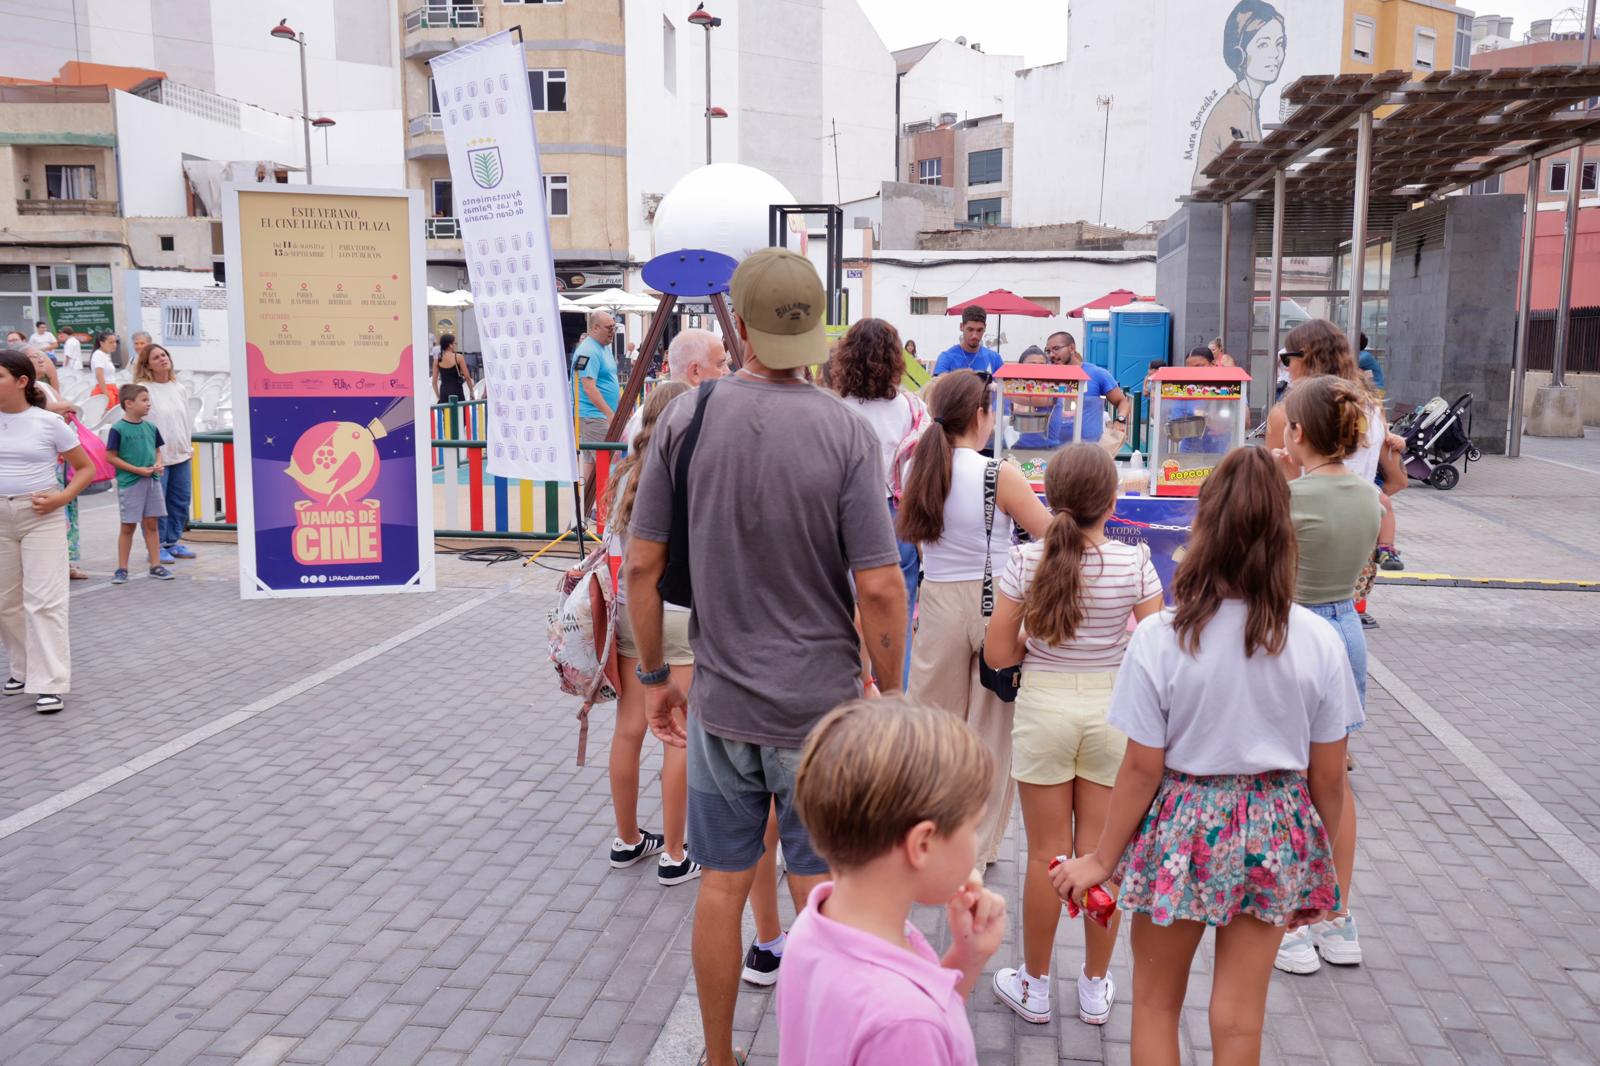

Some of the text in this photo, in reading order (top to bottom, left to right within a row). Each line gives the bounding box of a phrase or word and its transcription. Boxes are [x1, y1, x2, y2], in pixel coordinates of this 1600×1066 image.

[1184, 133, 1197, 160] Mara
[292, 207, 315, 217] ESTE
[261, 217, 273, 228] EL
[275, 218, 298, 229] CINE
[301, 219, 333, 230] LLEGA
[343, 220, 354, 231] TU
[358, 221, 391, 231] PLAZA
[301, 509, 377, 525] VAMOS DE
[1110, 526, 1142, 535] TODOS
[296, 526, 378, 561] CINE
